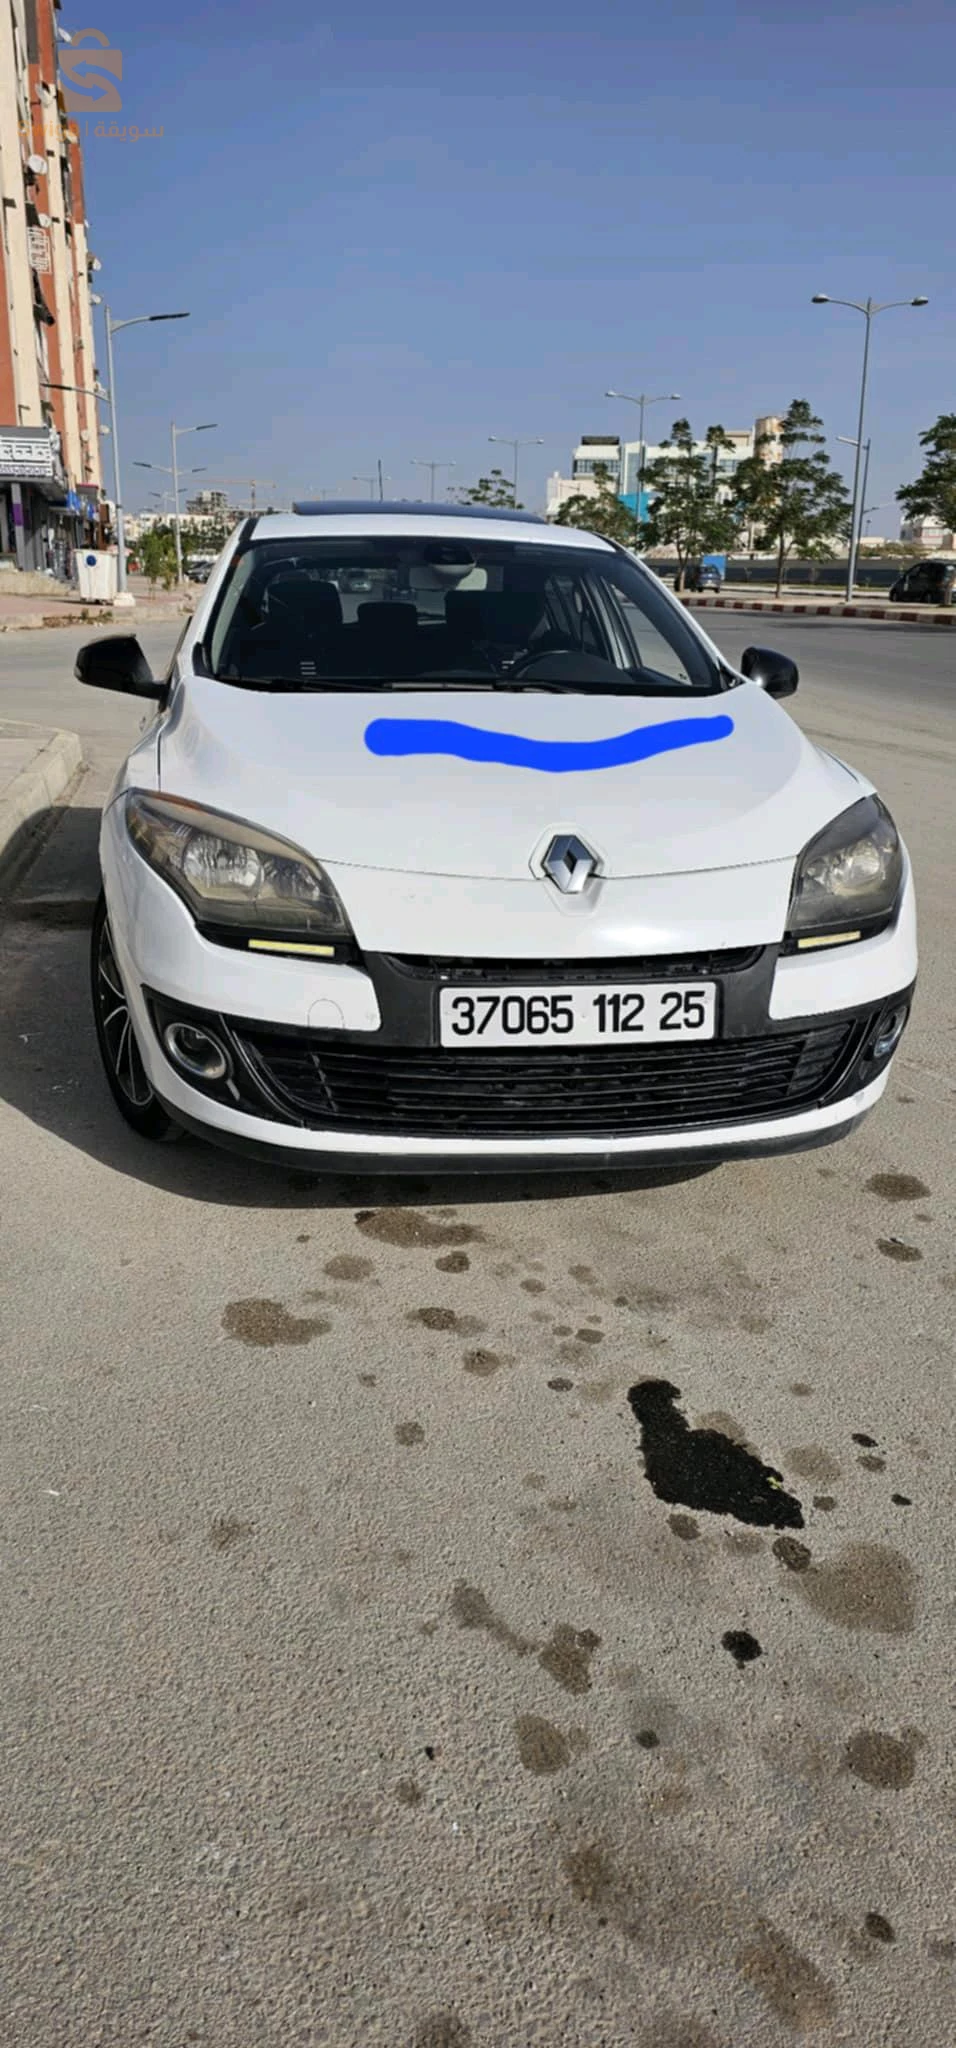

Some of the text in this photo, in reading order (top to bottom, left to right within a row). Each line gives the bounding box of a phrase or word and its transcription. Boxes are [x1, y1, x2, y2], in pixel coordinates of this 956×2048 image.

[452, 991, 706, 1035] 37065 112 25
